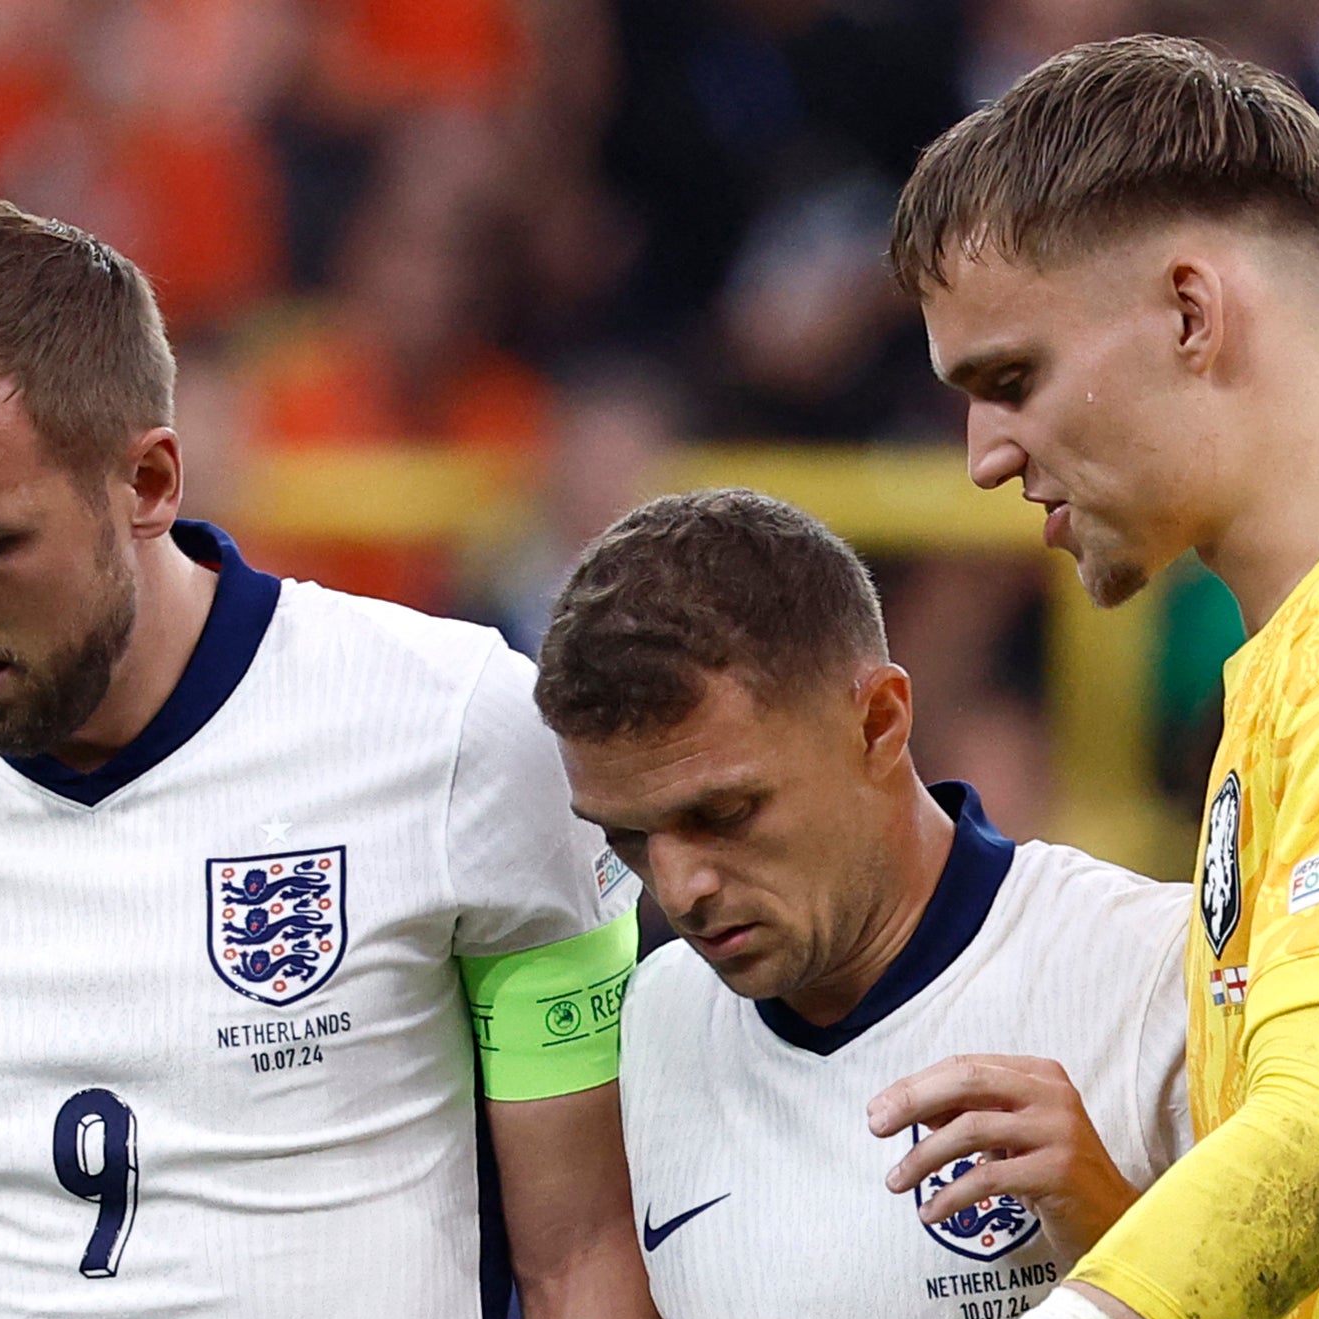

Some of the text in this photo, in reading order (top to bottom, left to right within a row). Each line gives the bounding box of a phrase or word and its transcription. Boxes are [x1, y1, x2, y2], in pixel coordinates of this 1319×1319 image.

[217, 1012, 352, 1048] NETHERLANDS
[251, 1044, 324, 1073] 10.07.24
[52, 1087, 138, 1279] 9
[926, 1262, 1057, 1299] NETHERLANDS
